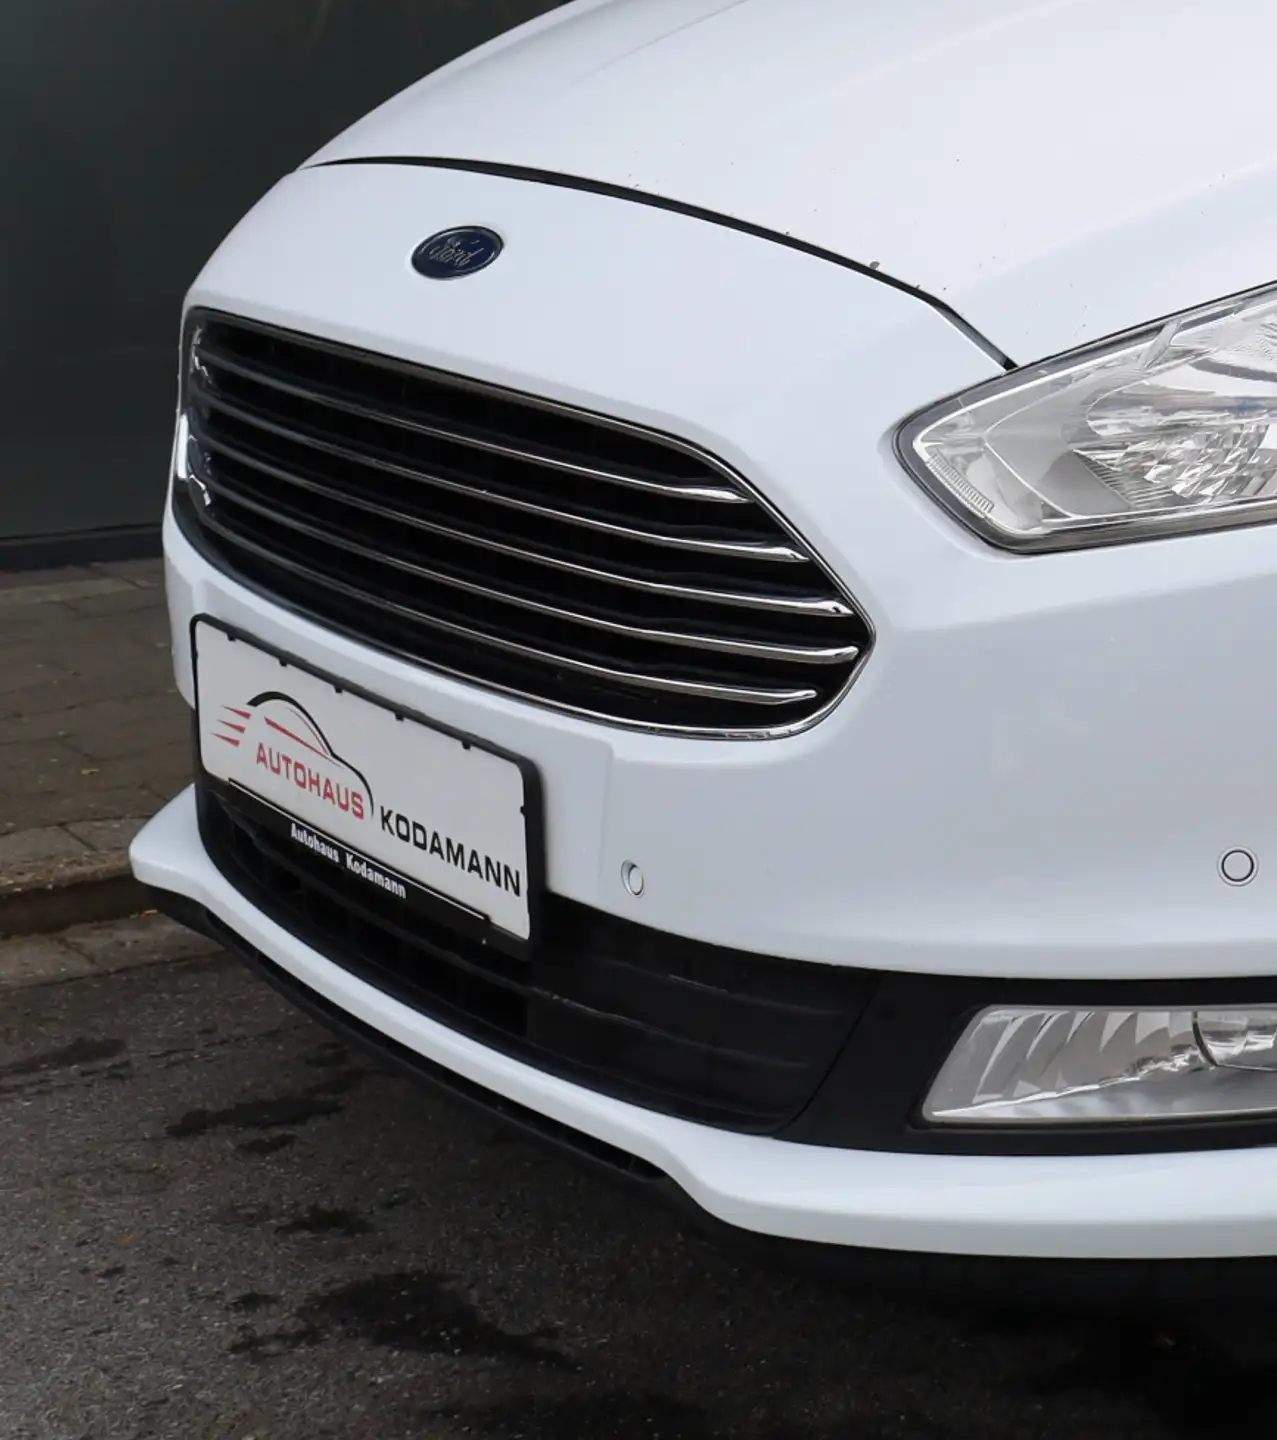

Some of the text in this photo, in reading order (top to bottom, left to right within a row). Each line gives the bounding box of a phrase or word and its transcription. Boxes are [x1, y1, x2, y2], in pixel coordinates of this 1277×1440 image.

[256, 742, 521, 898] AUTOHAUS KODAMANN
[290, 822, 407, 899] Autohaus Kodamann
